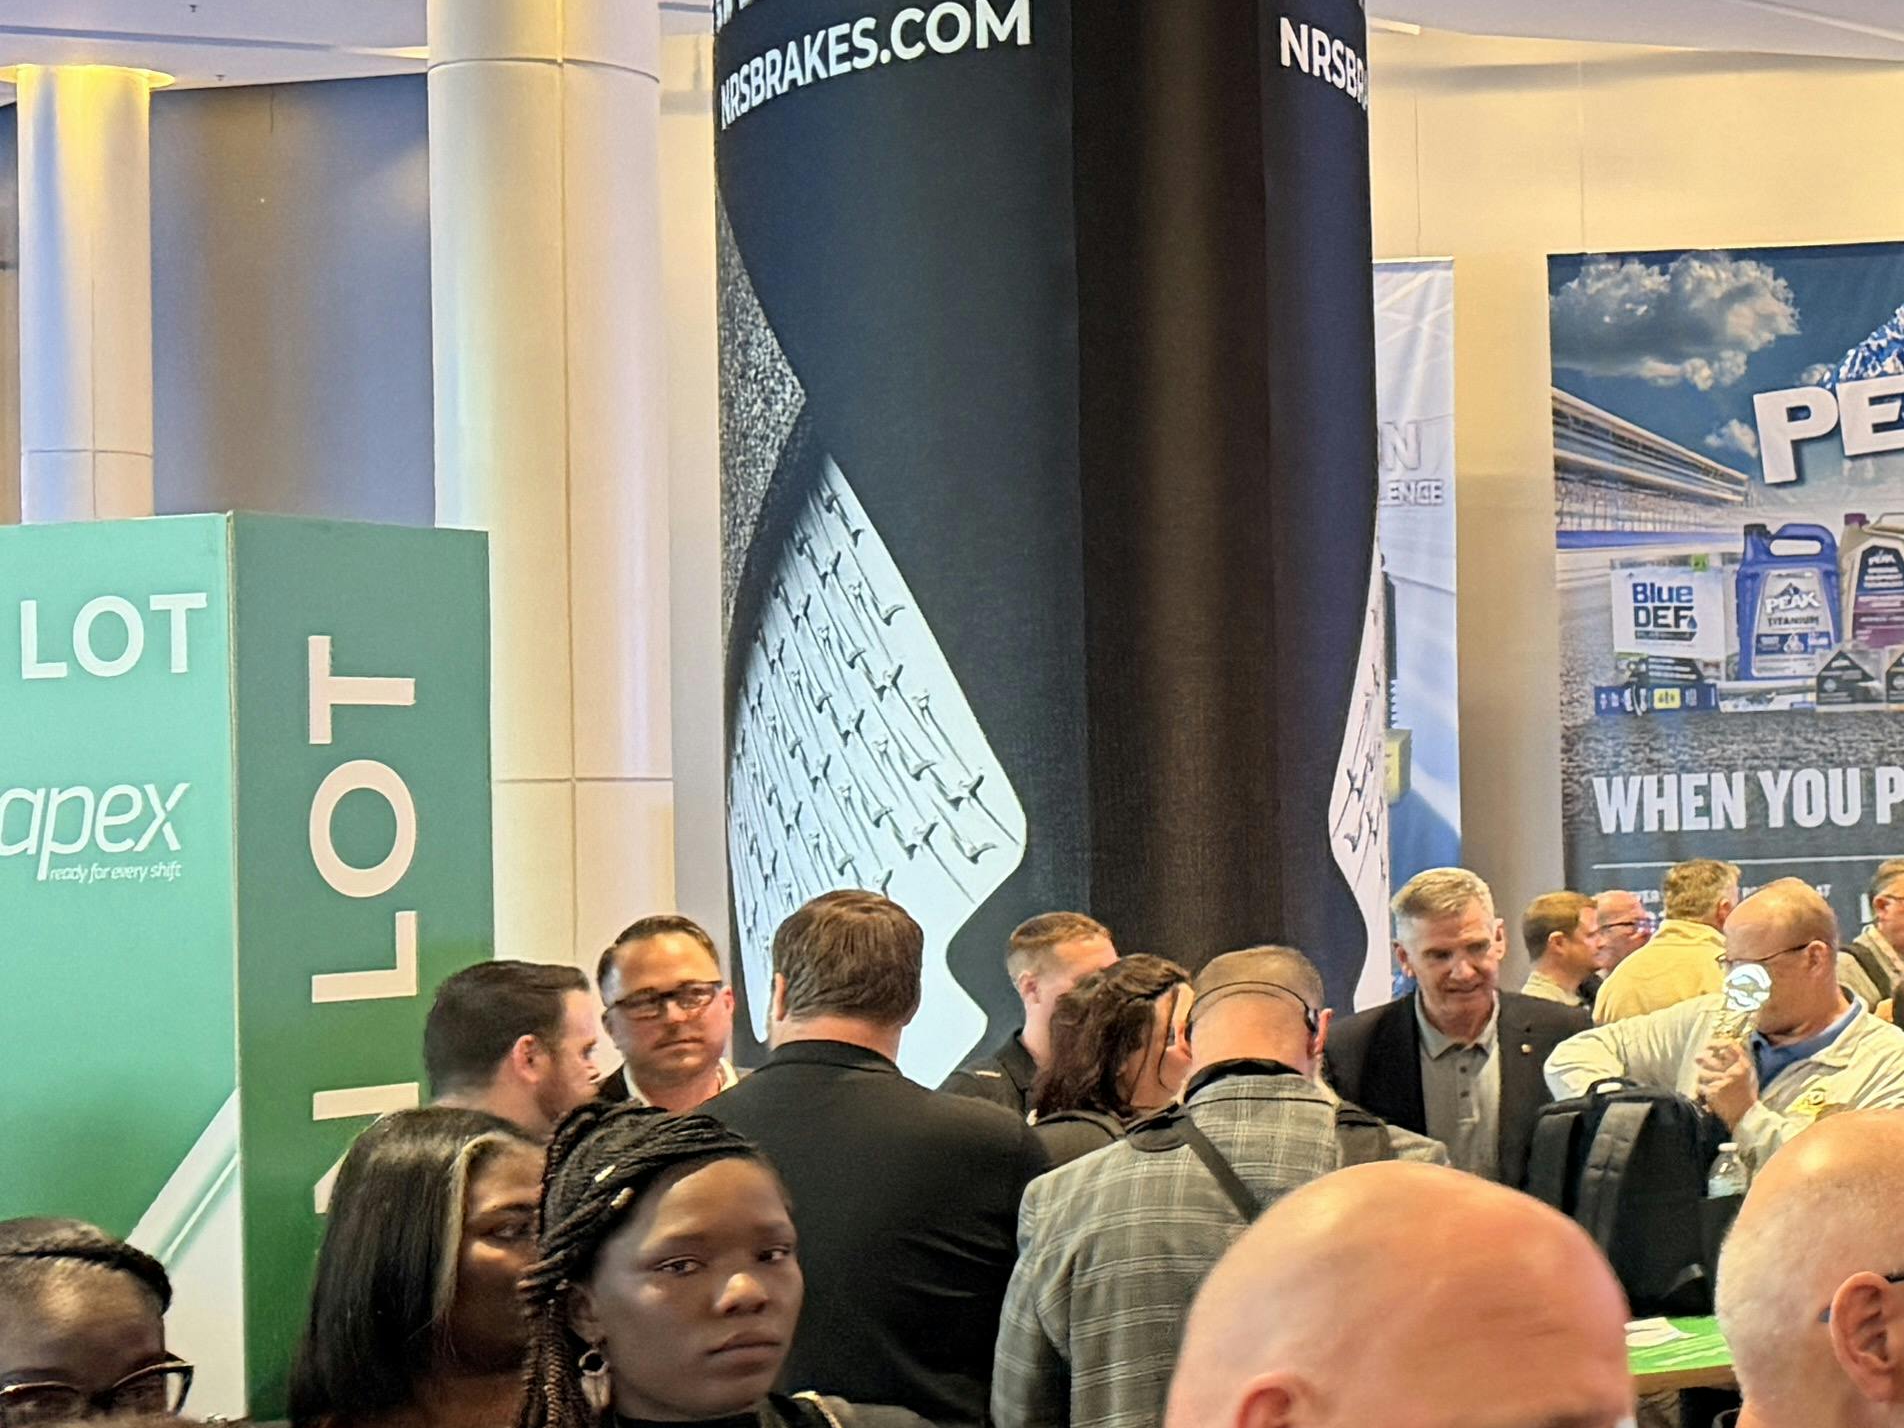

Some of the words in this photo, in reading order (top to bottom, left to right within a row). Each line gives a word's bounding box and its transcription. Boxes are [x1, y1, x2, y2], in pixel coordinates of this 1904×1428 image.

[1632, 582, 1693, 604] Blue
[1764, 591, 1823, 615] PEAK
[1633, 605, 1695, 629] DEF
[20, 592, 208, 680] LOT
[1592, 772, 1747, 835] WHEN
[1755, 768, 1863, 829] YOU
[307, 635, 418, 1004] LOT
[50, 863, 88, 884] ready
[87, 862, 111, 884] for
[111, 865, 149, 883] every
[149, 860, 183, 882] shift
